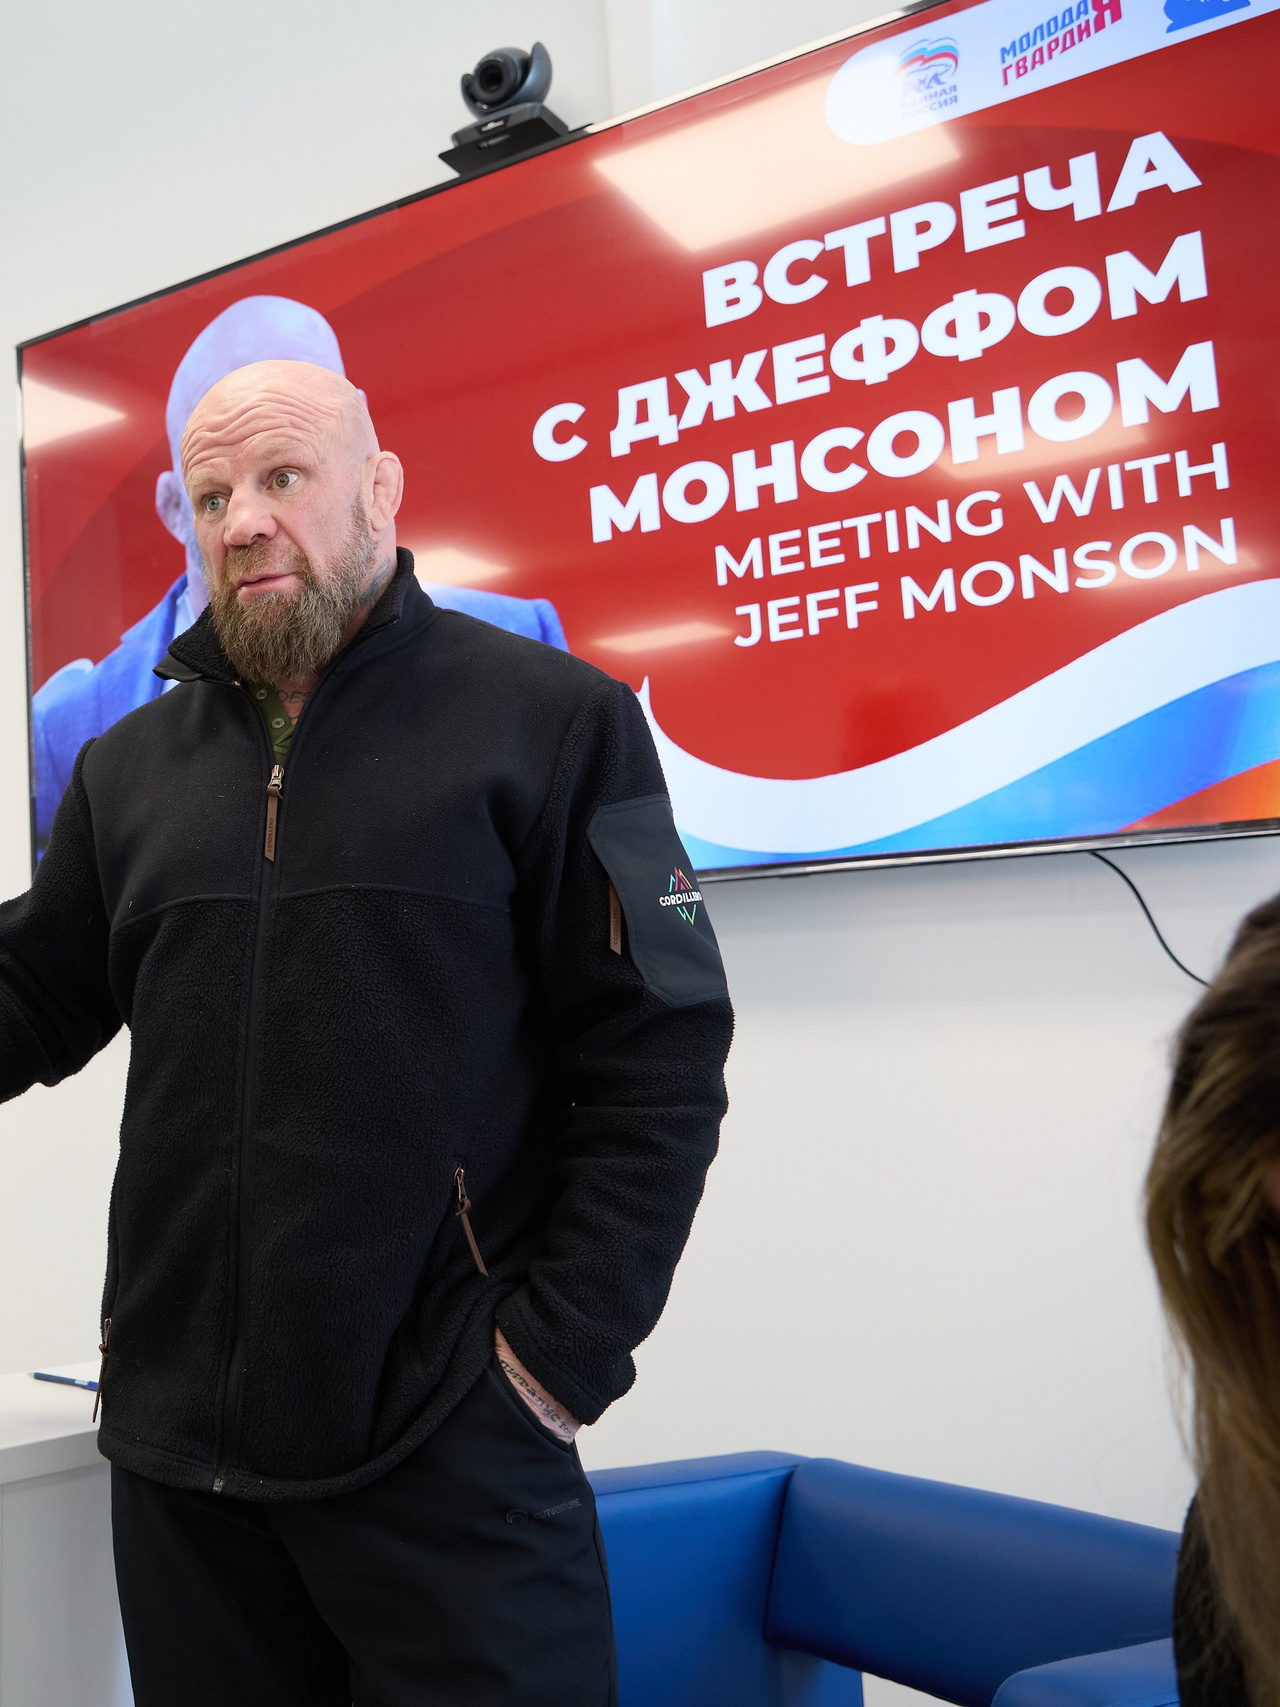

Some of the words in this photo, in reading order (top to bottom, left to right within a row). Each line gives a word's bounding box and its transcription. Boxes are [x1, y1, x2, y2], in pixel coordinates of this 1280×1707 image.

[702, 131, 1202, 327] ВСТРЕЧА
[610, 230, 1209, 457] ДЖЕФФОМ
[589, 340, 1221, 543] МОНСОНОМ
[715, 490, 1004, 586] MEETING
[1023, 442, 1230, 524] WITH
[734, 581, 879, 647] JEFF
[901, 517, 1238, 620] MONSON
[659, 891, 703, 907] CORDILLERO
